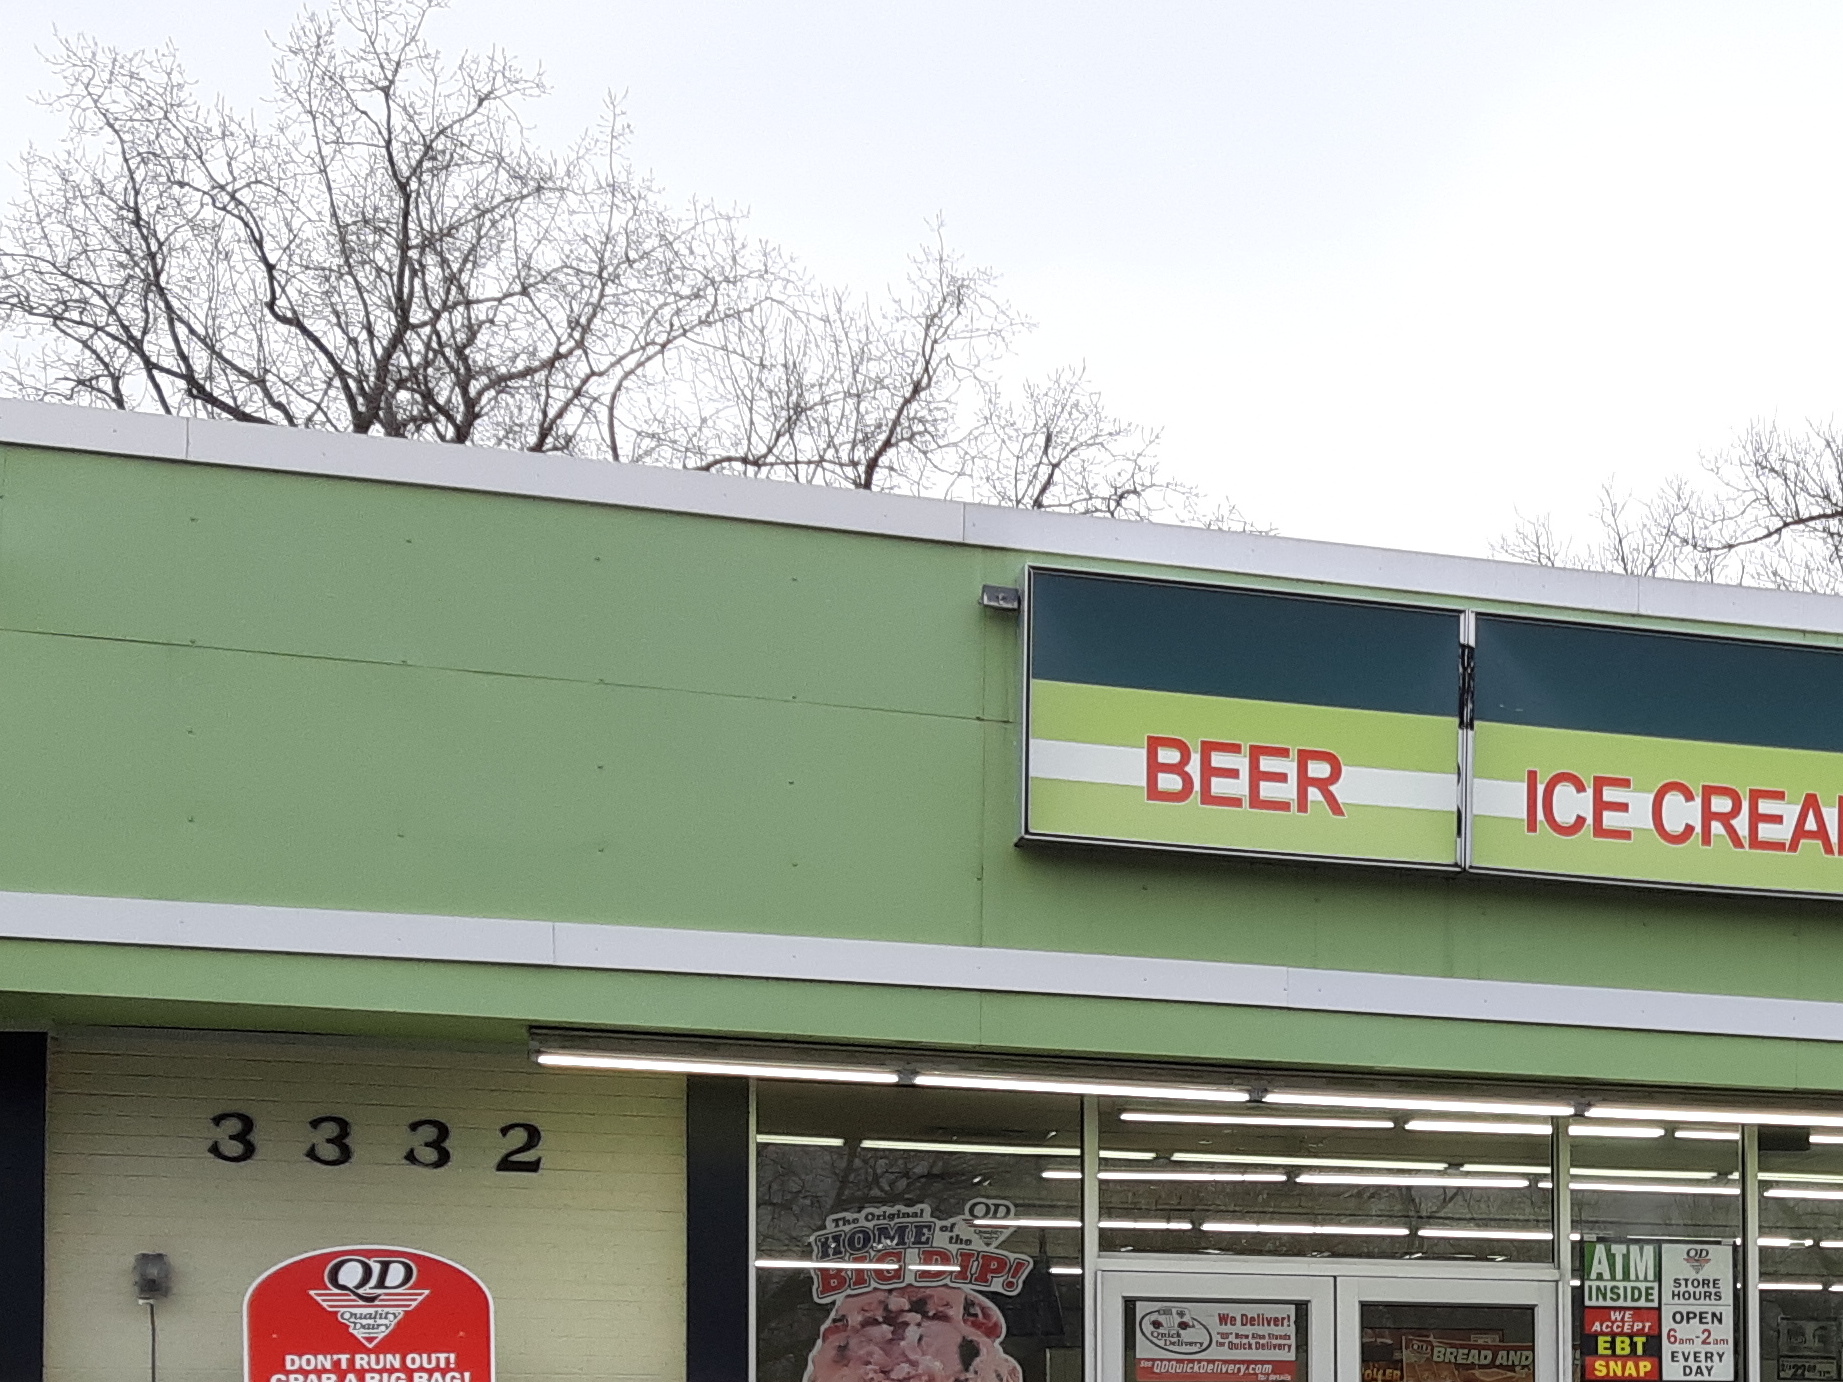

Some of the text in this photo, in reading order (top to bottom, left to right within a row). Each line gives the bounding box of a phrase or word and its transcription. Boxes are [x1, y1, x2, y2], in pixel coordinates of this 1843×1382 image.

[1144, 734, 1347, 818] BEER
[1525, 768, 1633, 842] ICE
[206, 1111, 543, 1173] 3332
[967, 1201, 1012, 1219] QD
[831, 1208, 925, 1229] The Original
[816, 1221, 957, 1261] HOME of
[948, 1234, 973, 1246] the
[1685, 1247, 1710, 1260] QD
[1589, 1243, 1655, 1281] ATM
[326, 1257, 415, 1303] QD
[816, 1247, 1031, 1298] BIG DIP!
[1672, 1277, 1722, 1289] STORE
[1587, 1284, 1656, 1303] INSIDE
[1671, 1290, 1723, 1302] HOURS
[340, 1309, 402, 1324] Quality
[1217, 1312, 1292, 1328] We Deliver!
[1610, 1310, 1634, 1321] WE
[1671, 1310, 1723, 1325] OPEN
[351, 1320, 392, 1332] Dairy
[1591, 1321, 1652, 1333] ACCEPT
[1150, 1329, 1183, 1341] Quick
[1163, 1338, 1205, 1349] Delivery
[1227, 1340, 1254, 1351] Quick
[1254, 1340, 1293, 1353] Delivery
[1597, 1335, 1647, 1356] EBT
[284, 1352, 456, 1371] DON'T RUN OUT!
[1432, 1346, 1534, 1366] BREAD AND
[1670, 1350, 1726, 1363] EVERY
[1152, 1360, 1273, 1376] QDQuickDelivery.com
[1362, 1368, 1402, 1382] OLLER
[1594, 1360, 1652, 1377] SNAP
[1682, 1364, 1715, 1377] DAY
